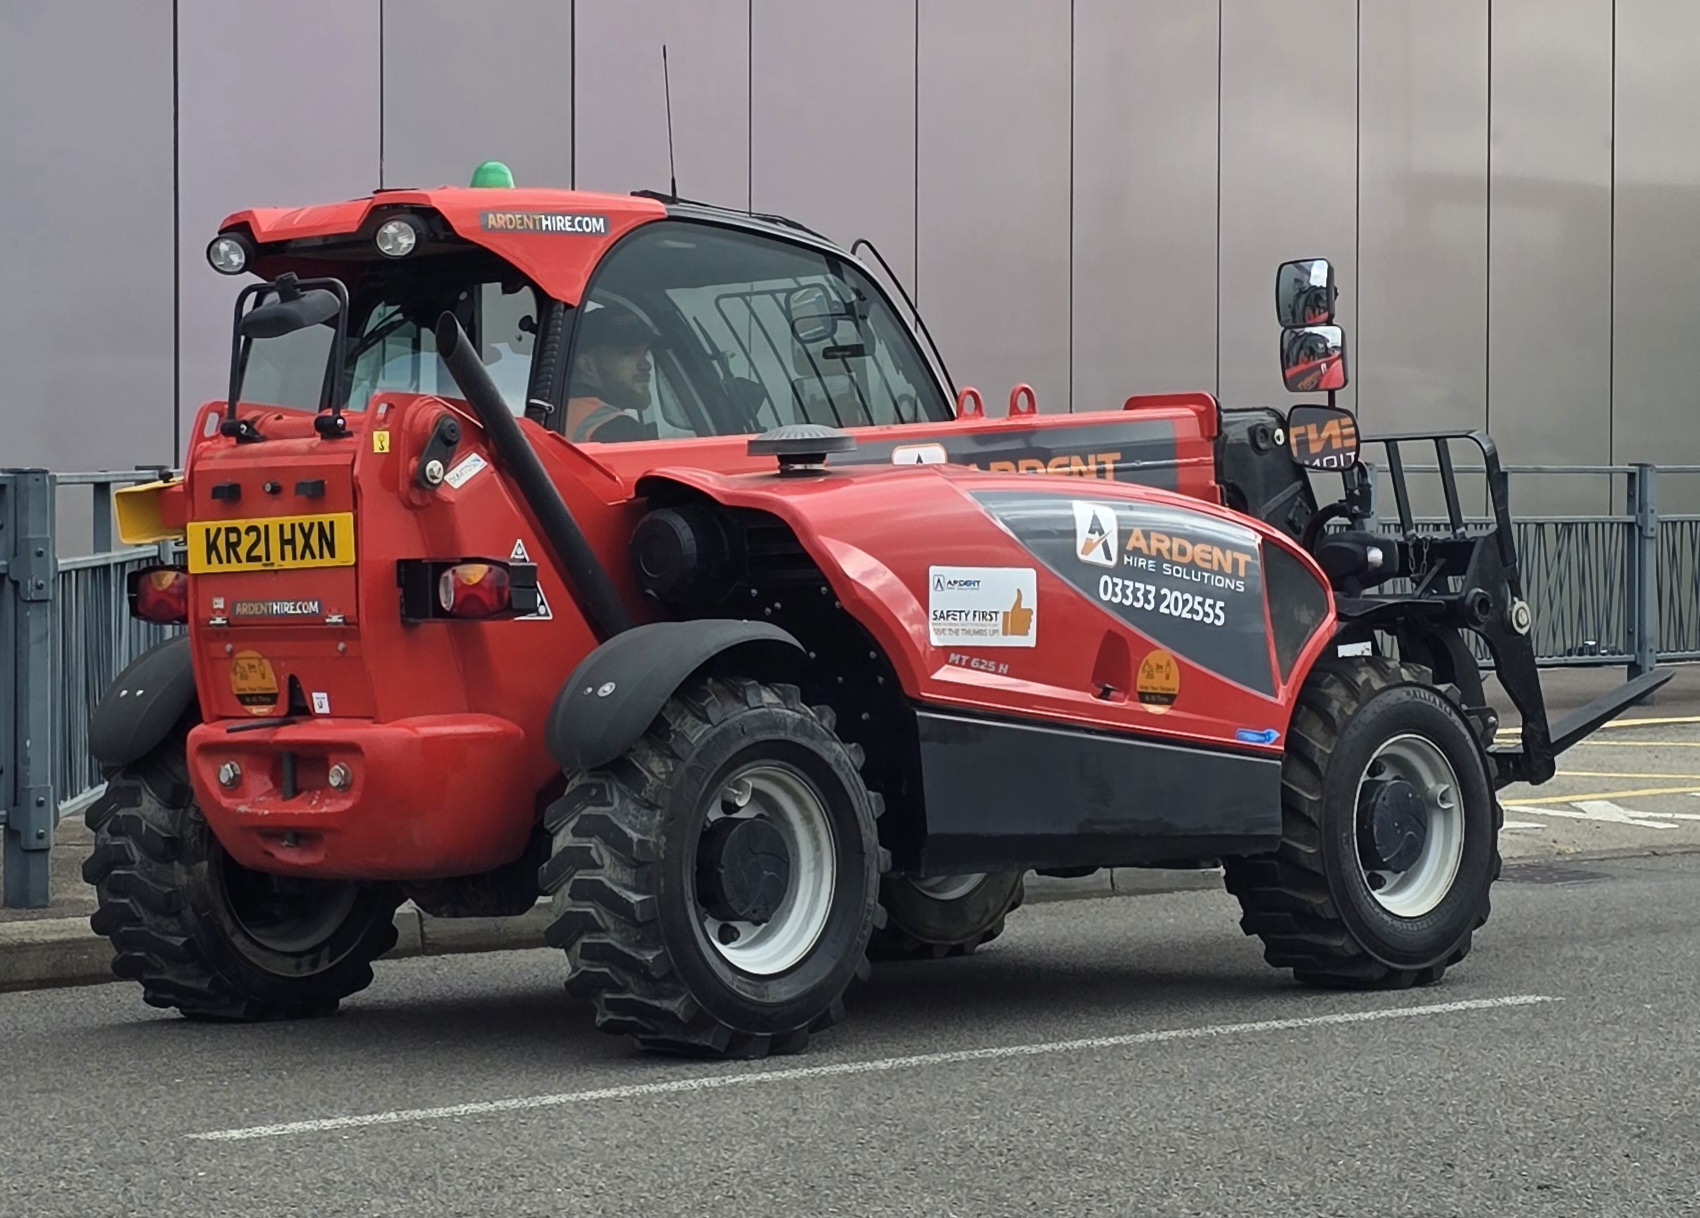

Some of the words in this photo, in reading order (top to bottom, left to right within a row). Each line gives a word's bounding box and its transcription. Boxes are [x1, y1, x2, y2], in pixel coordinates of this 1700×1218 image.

[487, 213, 605, 233] ARDENTHIRE.COM
[204, 524, 272, 566] KR21
[278, 520, 336, 562] HXN
[1126, 528, 1252, 577] ARDENT
[1123, 554, 1156, 572] HIRE
[1162, 563, 1246, 593] SOLUTIONS
[932, 609, 970, 622] SAFETY
[972, 610, 999, 622] FIRST
[1099, 574, 1156, 611] 03333
[1159, 587, 1226, 627] 202555
[949, 652, 970, 666] MT
[970, 657, 996, 672] 625
